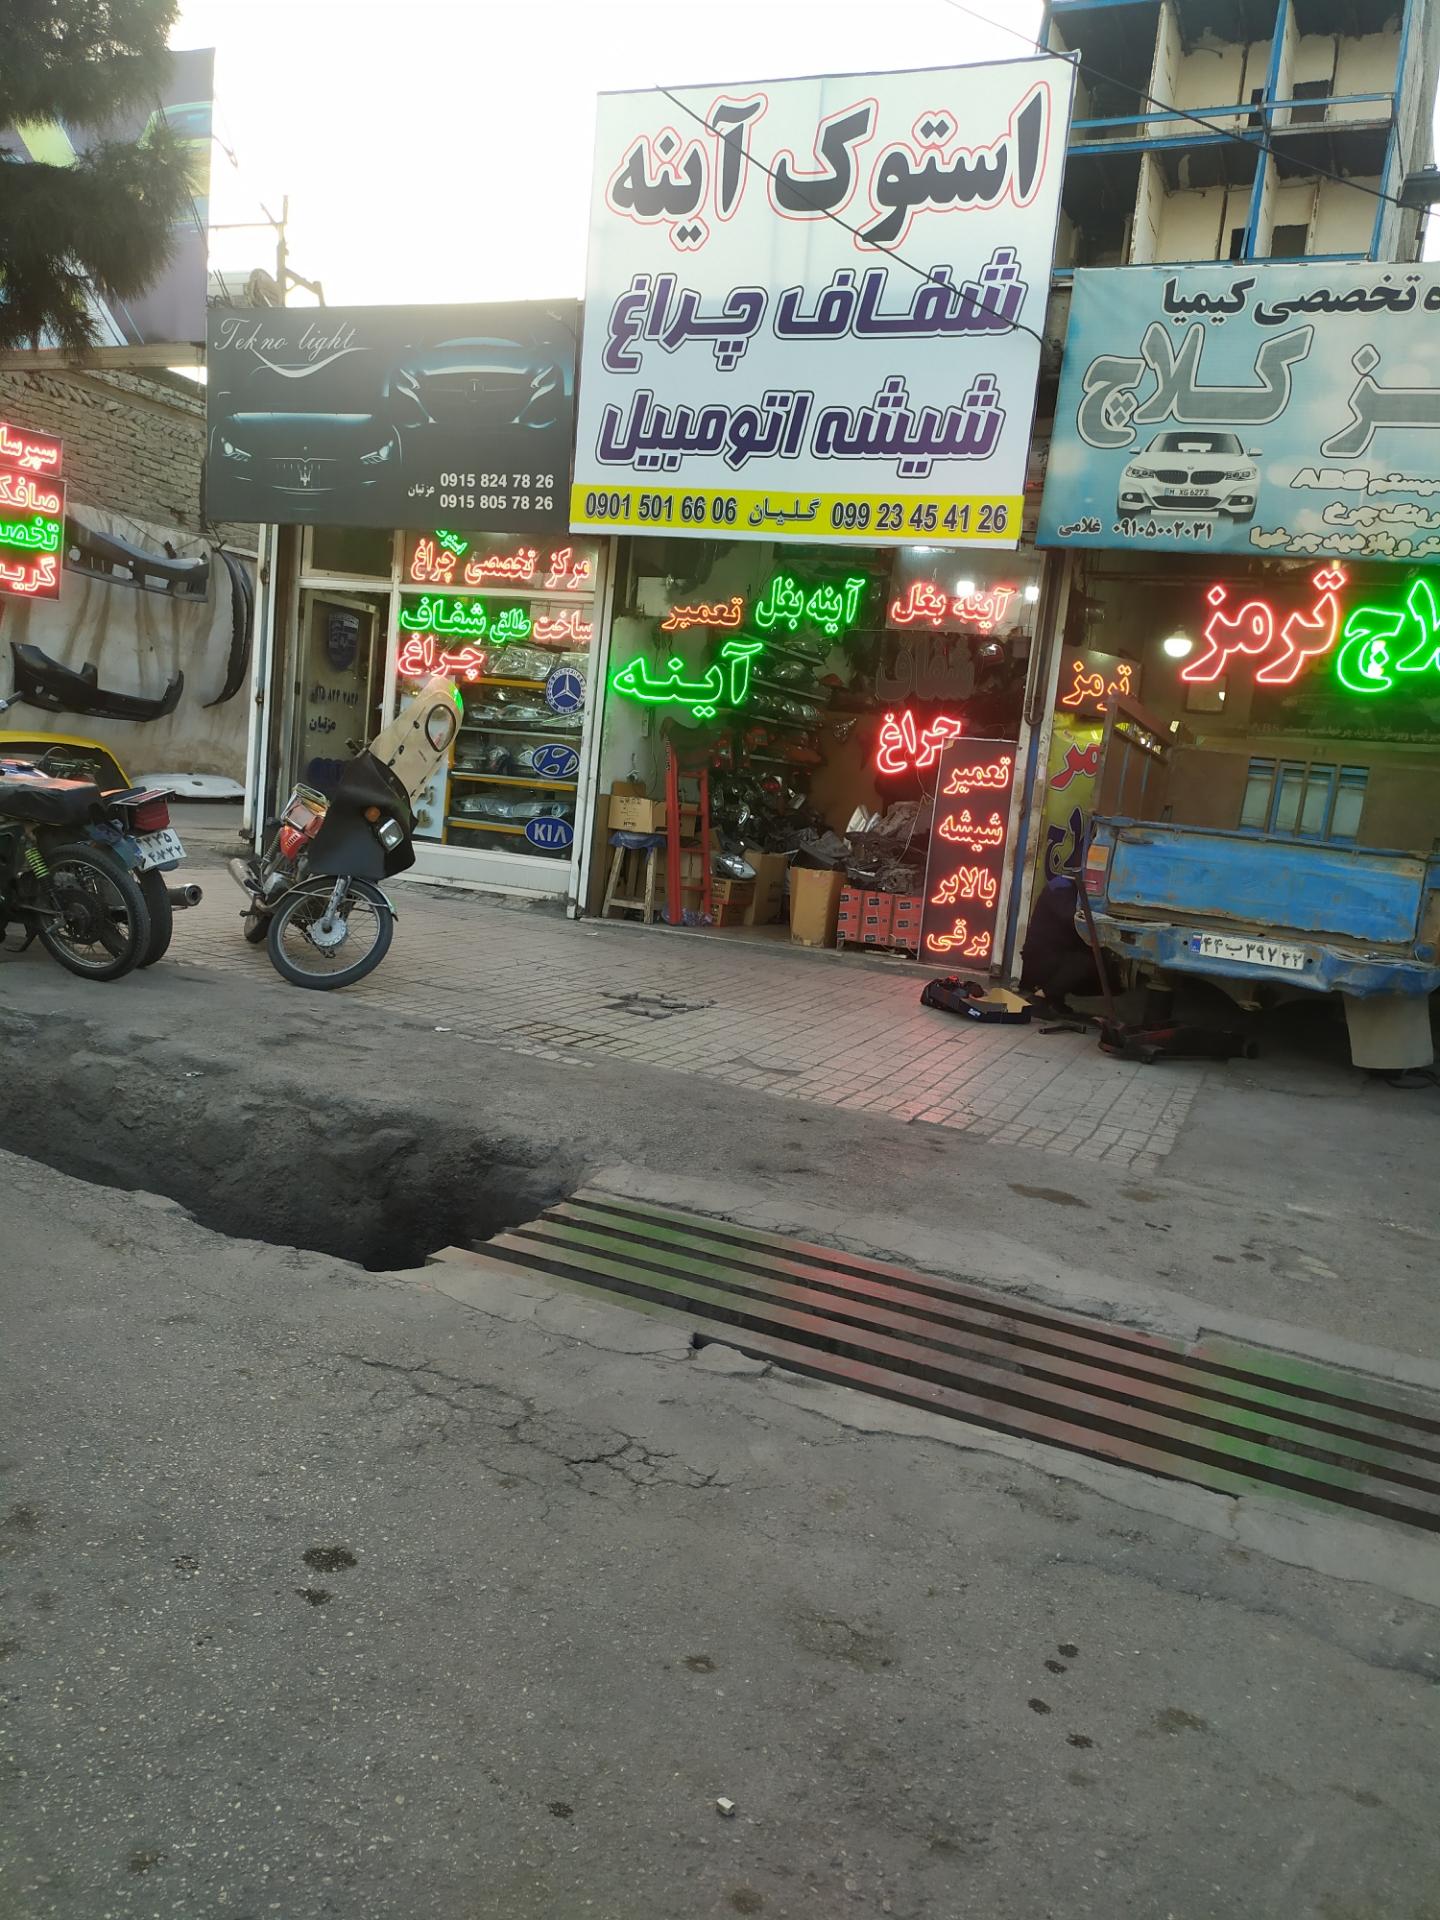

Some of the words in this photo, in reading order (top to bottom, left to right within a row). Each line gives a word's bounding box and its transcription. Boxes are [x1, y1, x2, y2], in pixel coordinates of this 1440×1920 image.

[608, 96, 765, 248] آینه
[770, 84, 1048, 248] استوک
[774, 248, 1027, 338] شفاف
[1162, 277, 1256, 324] کیمیا
[1254, 274, 1422, 325] تخصصی
[299, 322, 361, 362] light
[603, 273, 767, 372] چراغ
[1077, 322, 1314, 449] کلاچ
[0, 427, 22, 456] سا
[596, 389, 814, 472] اتومبیل
[811, 374, 1006, 479] شیشه
[0, 476, 59, 513] صافک
[440, 472, 476, 487] 0915
[480, 473, 507, 488] 824
[512, 474, 531, 488] 78
[535, 474, 554, 488] 26
[439, 494, 475, 508] 0915
[480, 495, 507, 509] 805
[511, 495, 530, 510] 78
[535, 496, 553, 510] 26
[585, 492, 631, 519] 0901
[638, 494, 673, 520] 501
[680, 495, 705, 522] 66
[711, 497, 737, 524] 06
[748, 498, 821, 526] گلیان
[831, 502, 870, 529] 099
[876, 502, 903, 530] 23
[909, 504, 938, 531] 45
[943, 504, 970, 531] 41
[977, 504, 1007, 532] 26
[0, 517, 59, 551] تخص
[1058, 516, 1102, 536] غلامی
[411, 539, 457, 584] چراغ
[464, 548, 537, 584] تخصصی
[545, 548, 592, 588] مرکز
[401, 597, 487, 635] شفاف
[661, 597, 744, 630] تعمیر
[755, 576, 804, 630] بغل
[806, 577, 866, 634] آینه
[892, 584, 947, 625] بغل
[953, 586, 1015, 629] آینه
[533, 610, 593, 640] ساخت
[1182, 570, 1346, 684] ترمز
[398, 632, 486, 680] چراغ
[613, 642, 763, 718] آینه
[943, 756, 1011, 794] تعمیر
[533, 822, 568, 845] KIA
[939, 810, 1003, 852] شیشه
[931, 866, 998, 907] بالابر
[927, 918, 991, 956] برقی
